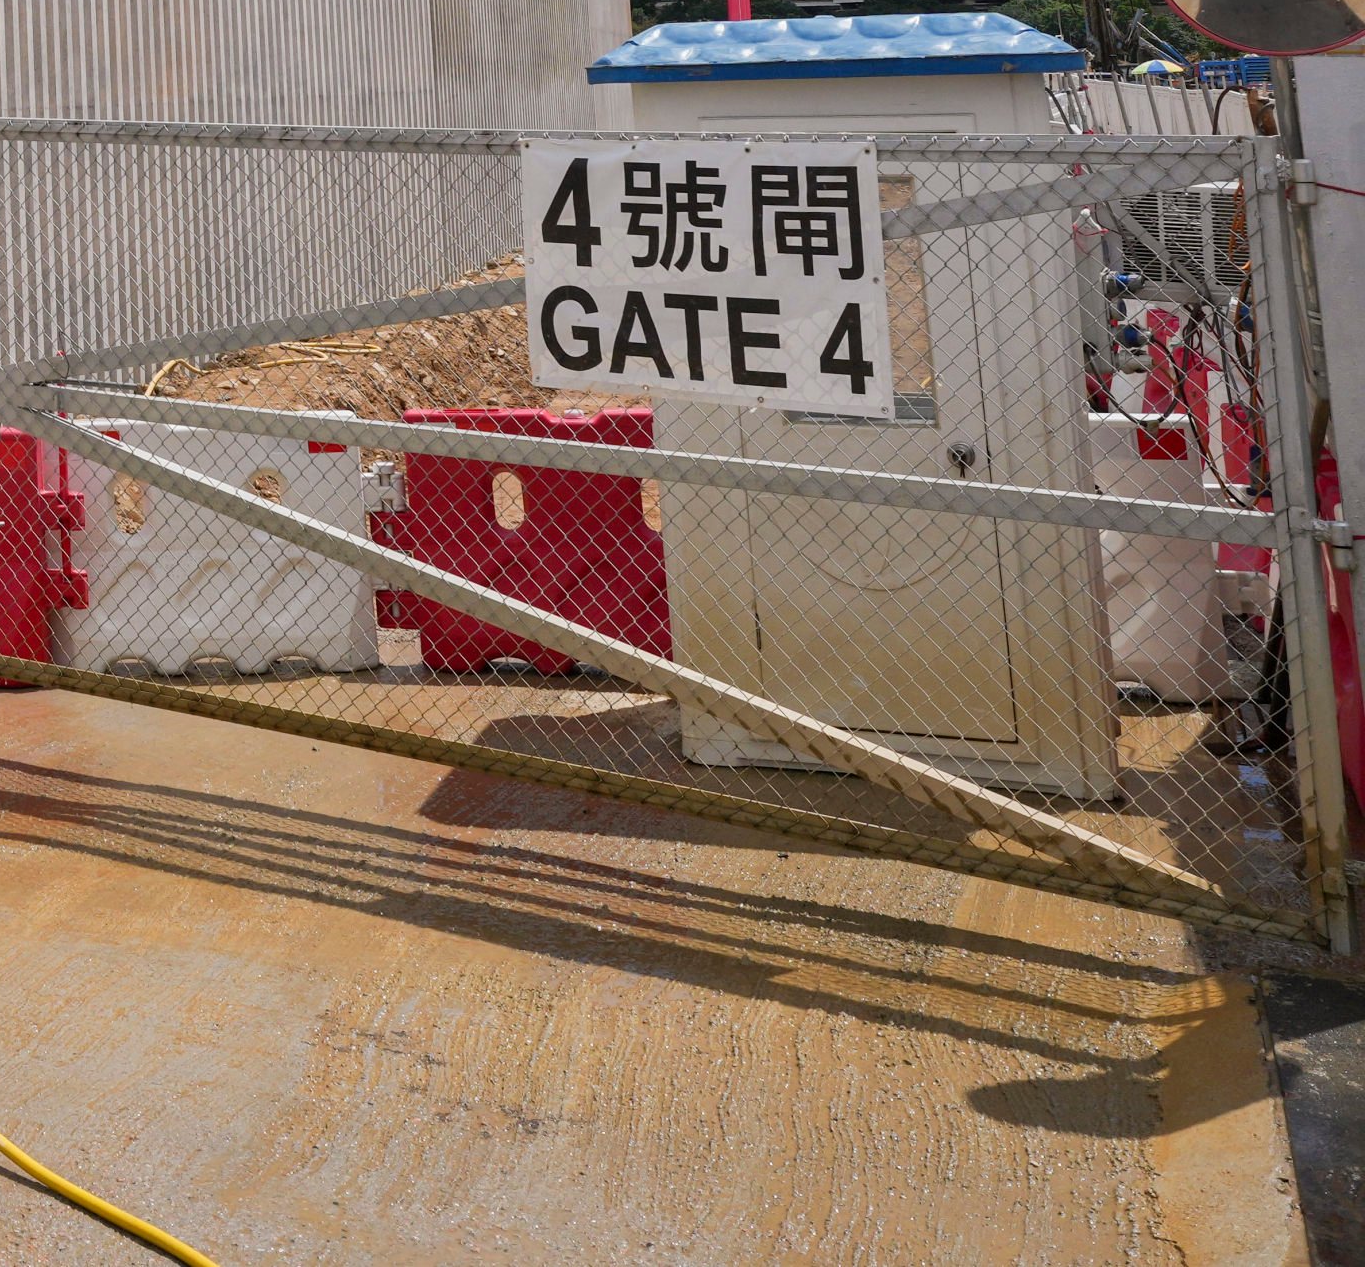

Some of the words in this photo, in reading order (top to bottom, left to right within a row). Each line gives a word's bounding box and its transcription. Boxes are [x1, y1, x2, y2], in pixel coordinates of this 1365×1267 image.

[541, 157, 866, 281] 4號閘
[540, 285, 788, 389] GATE
[819, 302, 874, 395] 4
